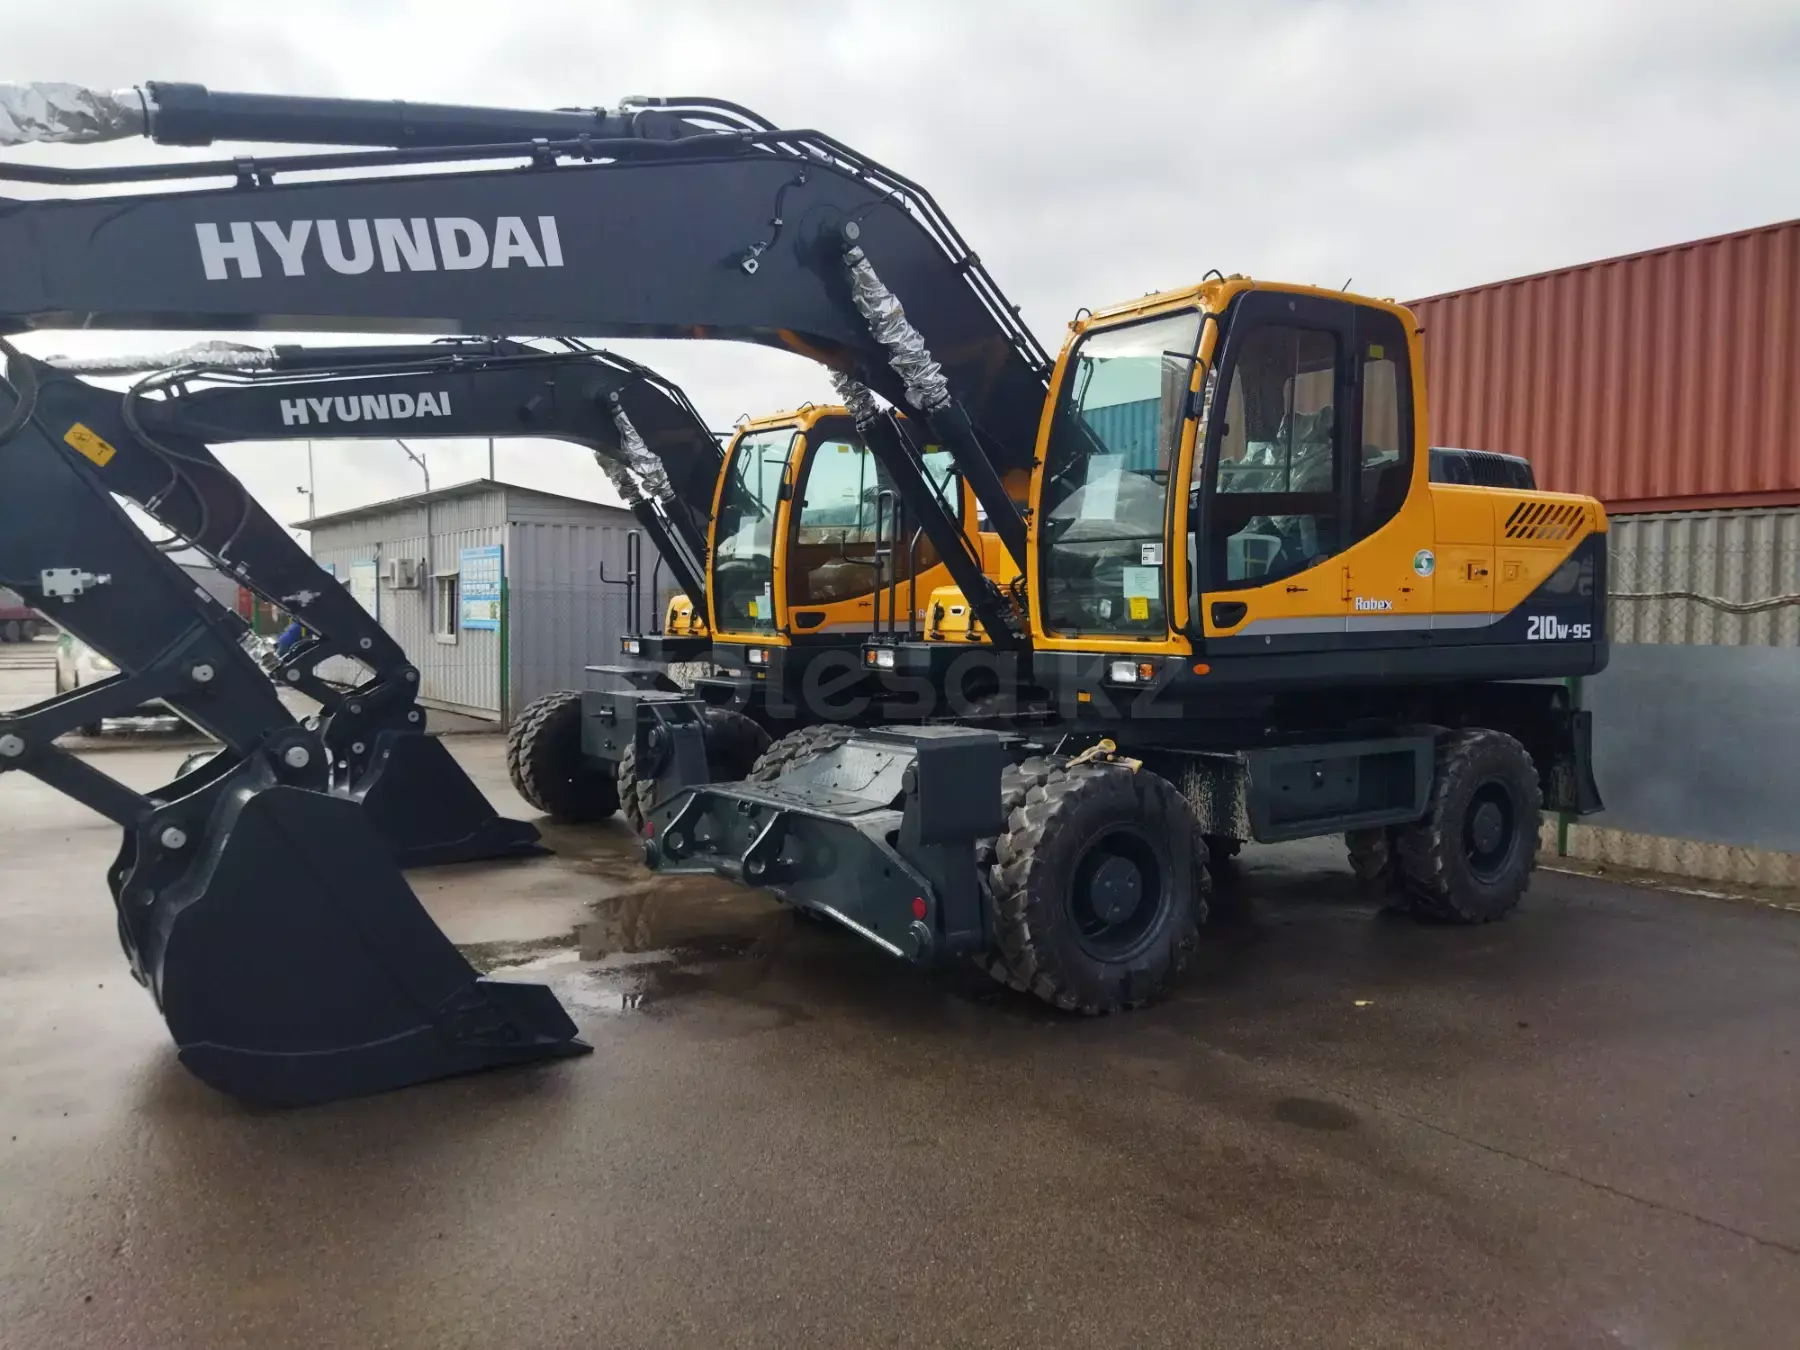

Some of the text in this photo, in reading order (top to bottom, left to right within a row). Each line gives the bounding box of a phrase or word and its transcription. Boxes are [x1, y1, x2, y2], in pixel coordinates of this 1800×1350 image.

[195, 215, 564, 280] HYUNDAI
[280, 391, 452, 425] HYUNDAI
[1355, 597, 1392, 611] Robex
